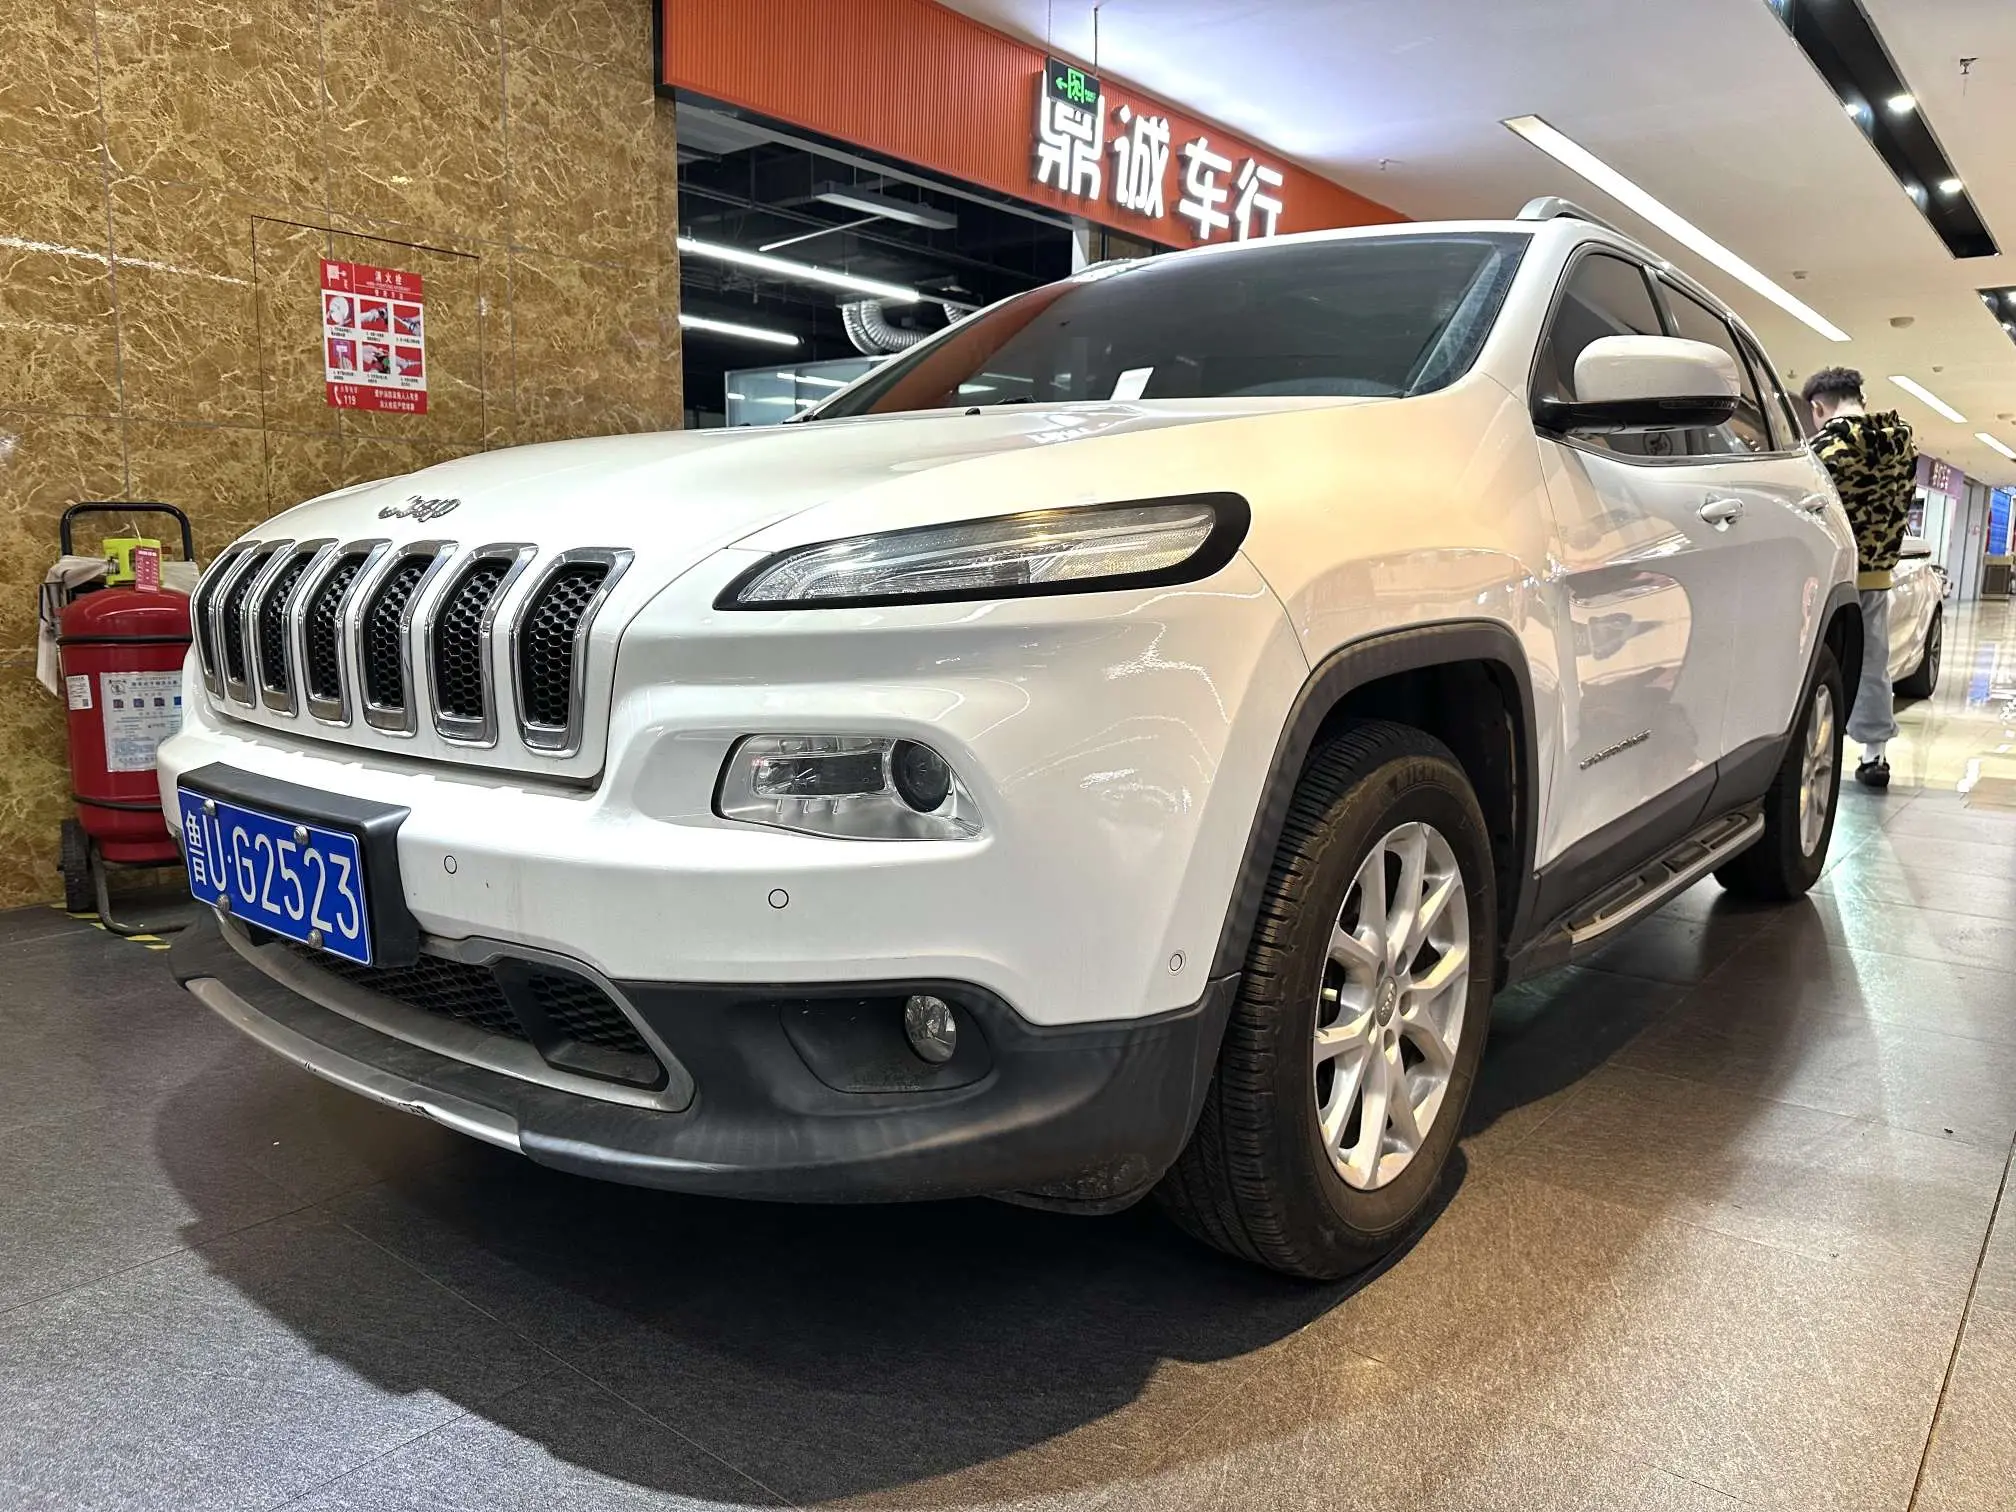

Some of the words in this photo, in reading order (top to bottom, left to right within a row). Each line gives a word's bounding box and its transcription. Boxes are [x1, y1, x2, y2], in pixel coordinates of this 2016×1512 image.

[1037, 69, 1283, 242] 鼎诚车行
[343, 394, 357, 406] 119
